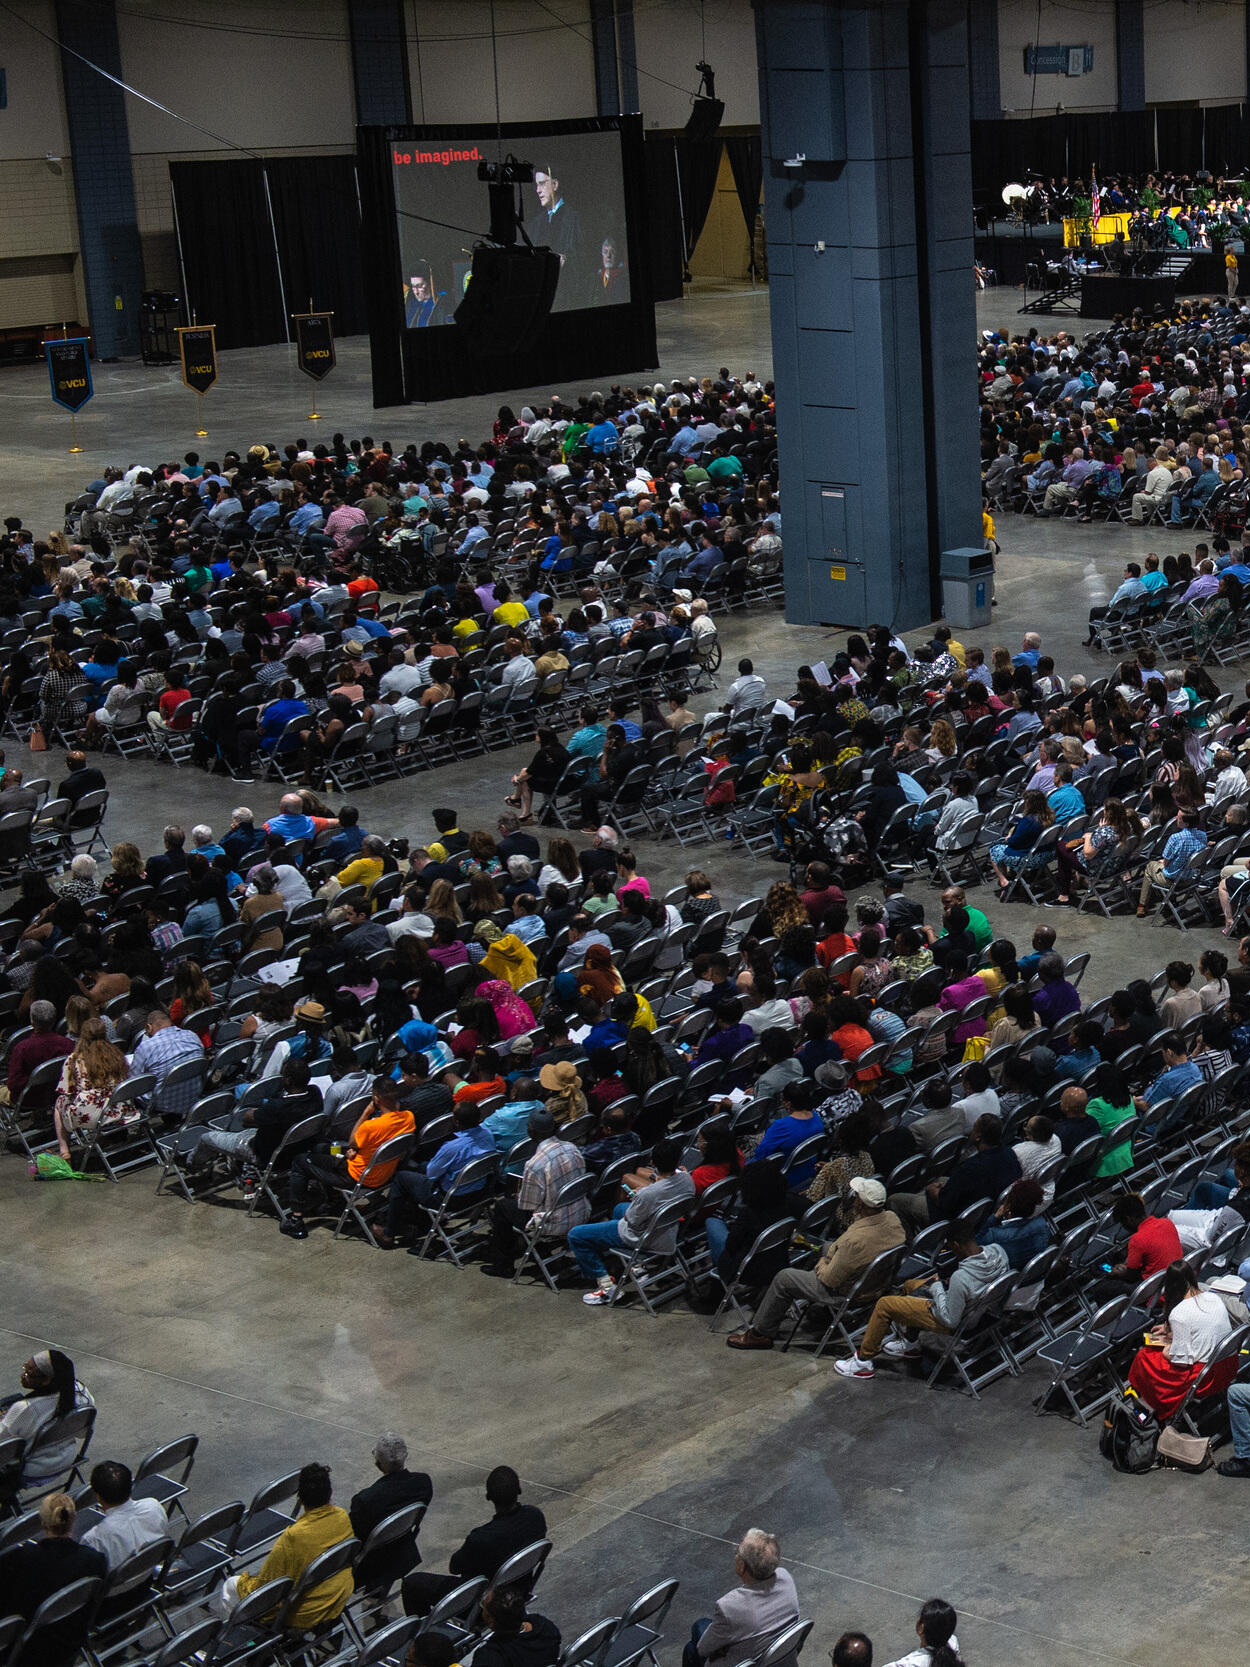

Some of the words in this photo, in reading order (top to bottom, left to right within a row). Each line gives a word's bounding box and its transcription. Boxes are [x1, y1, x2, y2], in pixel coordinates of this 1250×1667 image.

[393, 150, 411, 165] be
[415, 146, 484, 166] imagined.
[312, 350, 330, 359] VCU
[196, 364, 212, 374] VCU
[66, 378, 86, 389] VCU
